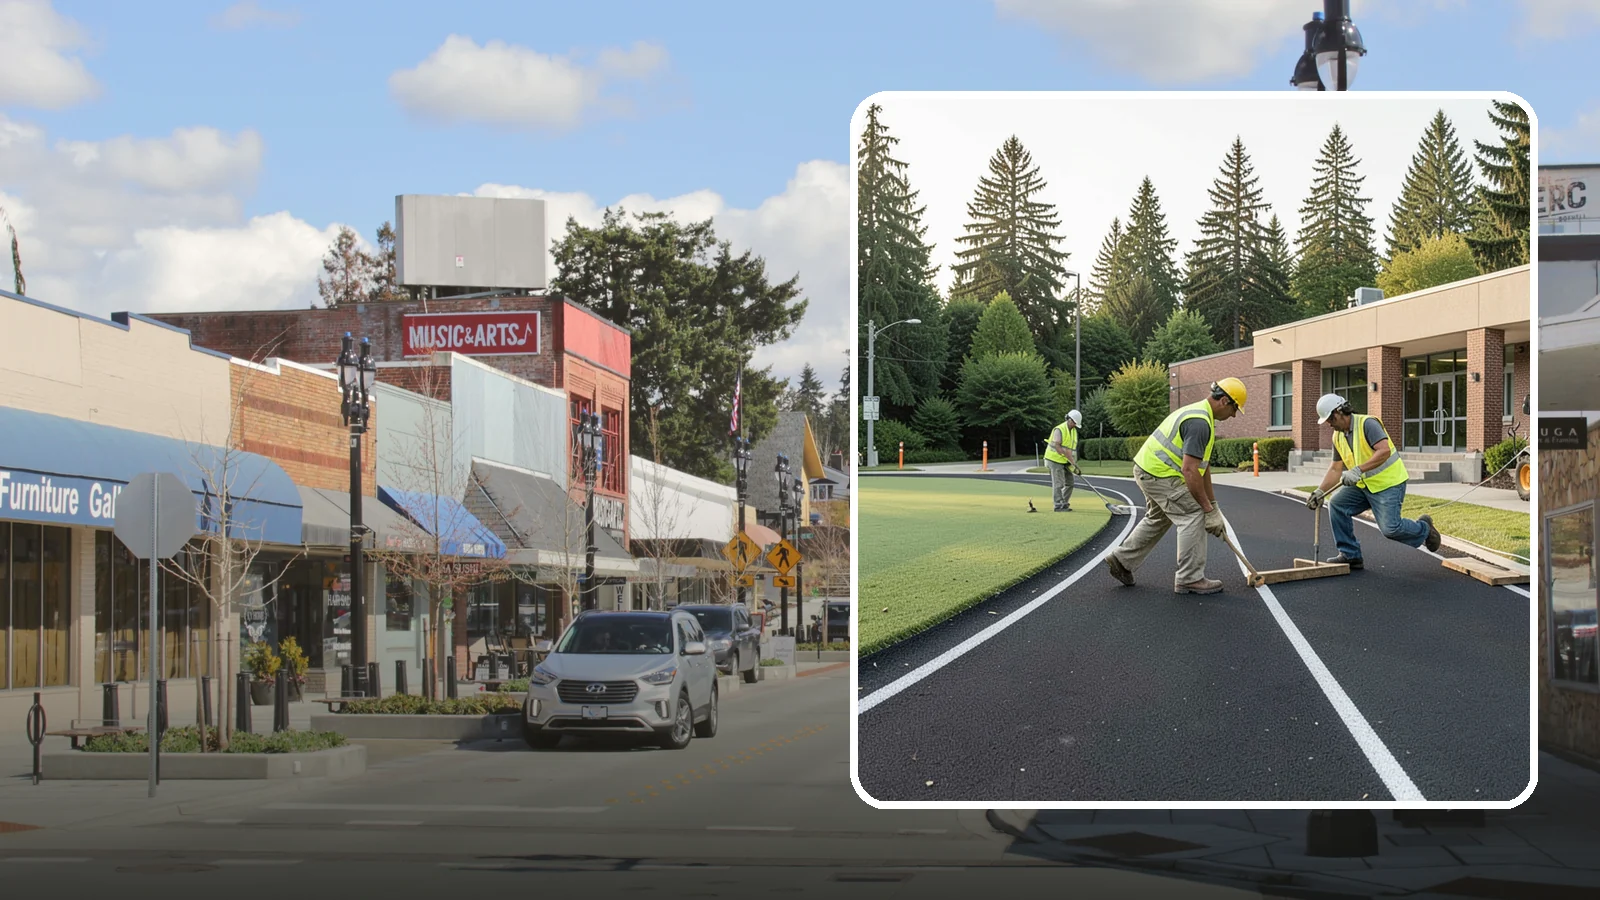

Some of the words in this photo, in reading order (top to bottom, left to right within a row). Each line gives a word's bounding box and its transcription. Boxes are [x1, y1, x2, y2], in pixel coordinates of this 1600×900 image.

[0, 472, 79, 515] Furniture
[89, 483, 122, 519] Gal
[453, 564, 480, 574] SUSHI
